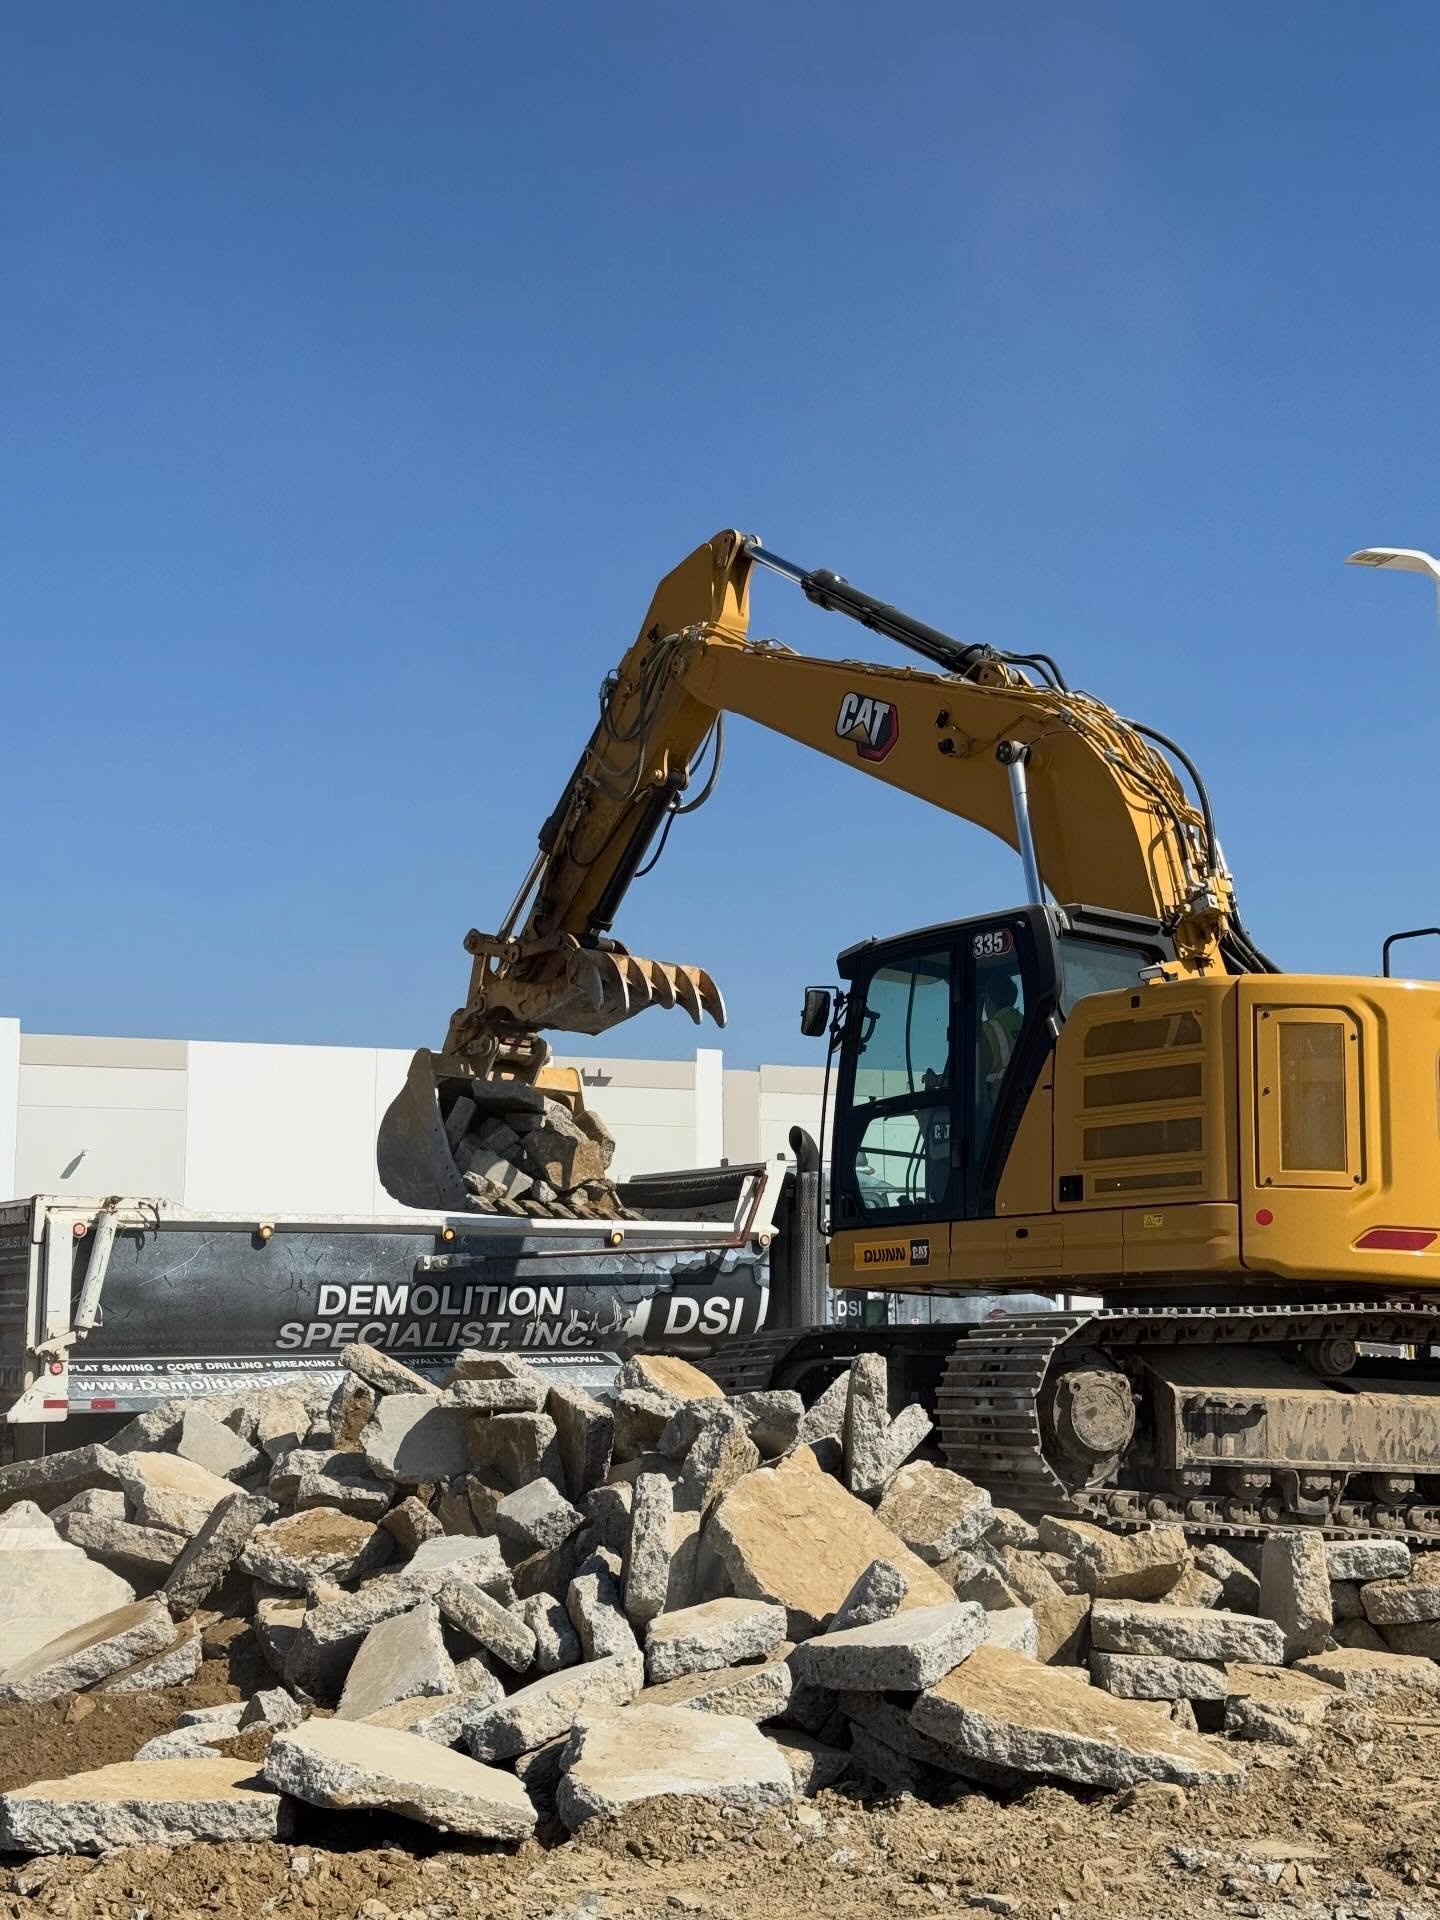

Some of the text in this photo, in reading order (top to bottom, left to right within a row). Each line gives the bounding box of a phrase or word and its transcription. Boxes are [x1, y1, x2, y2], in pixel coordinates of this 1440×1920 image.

[837, 693, 890, 746] CAT
[974, 931, 1003, 956] 335
[863, 1246, 928, 1263] QUINN CAT
[317, 1285, 565, 1316] DEMOLITION
[837, 1300, 862, 1317] DSI
[664, 1296, 744, 1335] DSI
[275, 1321, 594, 1350] SPECIALIST, INC.
[68, 1364, 99, 1372] FLAT
[101, 1364, 155, 1372] SAWING
[166, 1362, 203, 1371] CORE
[205, 1361, 263, 1370] DRILLING
[271, 1360, 336, 1368] BREAKING
[551, 1356, 604, 1364] REMOVAL
